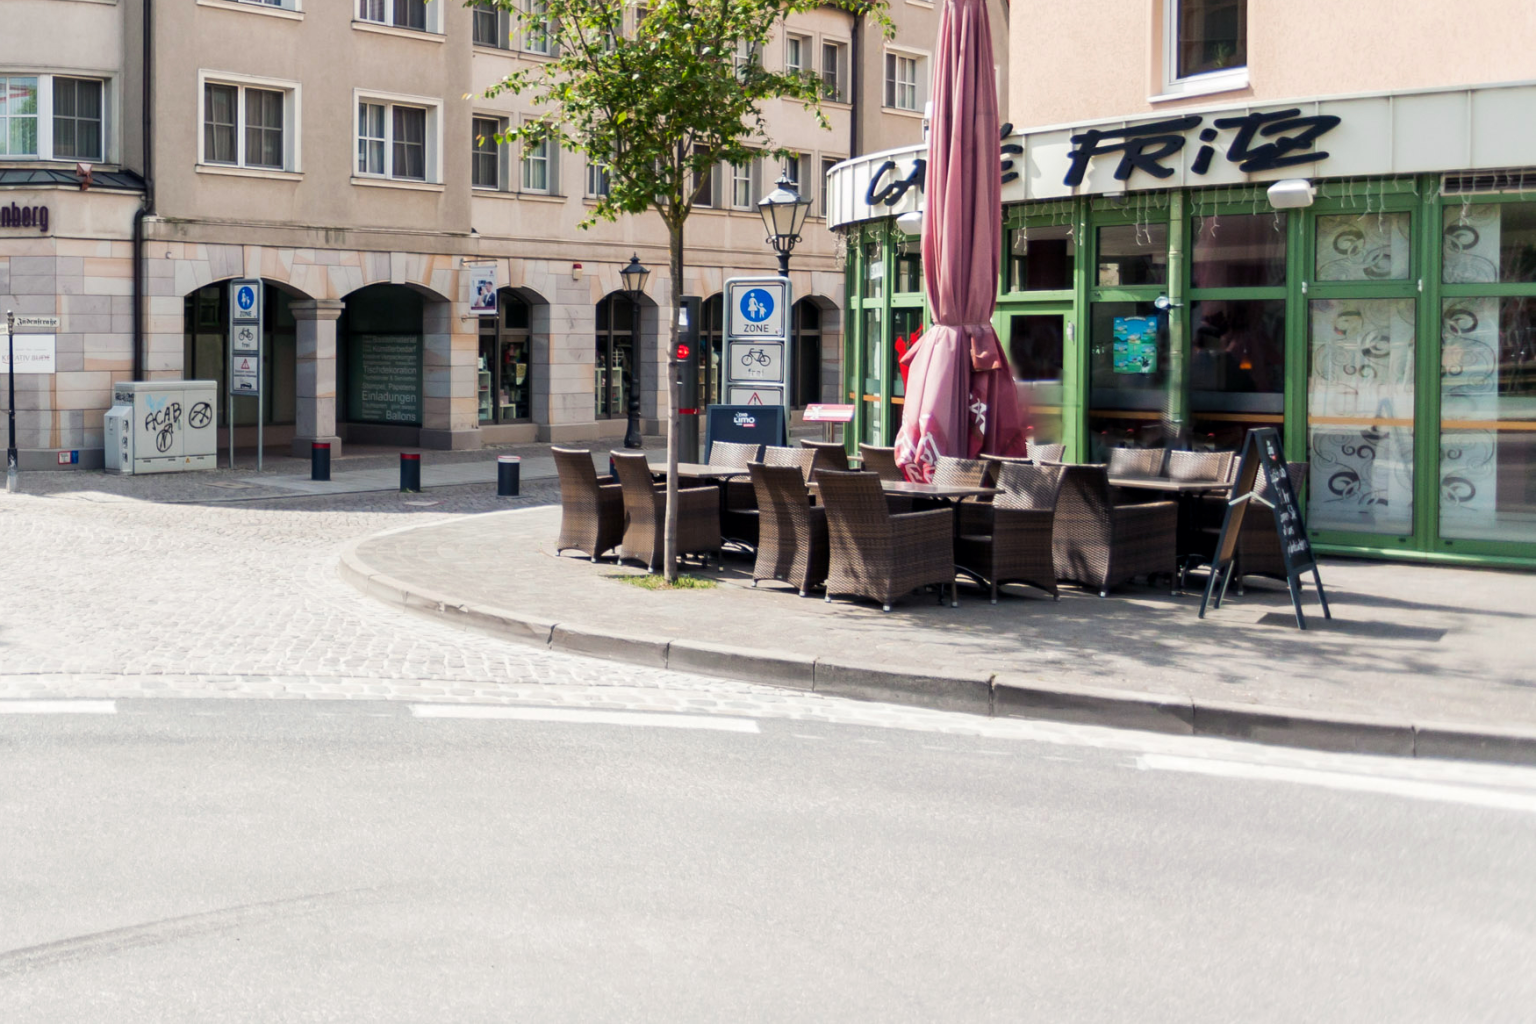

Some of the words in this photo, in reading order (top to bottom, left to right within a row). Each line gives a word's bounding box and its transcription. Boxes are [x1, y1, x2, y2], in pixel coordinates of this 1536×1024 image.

[865, 123, 1023, 205] CAÉ
[744, 324, 769, 332] ZONE
[362, 391, 417, 404] Einladungen
[145, 402, 182, 431] ACAB
[386, 410, 416, 422] Ballons
